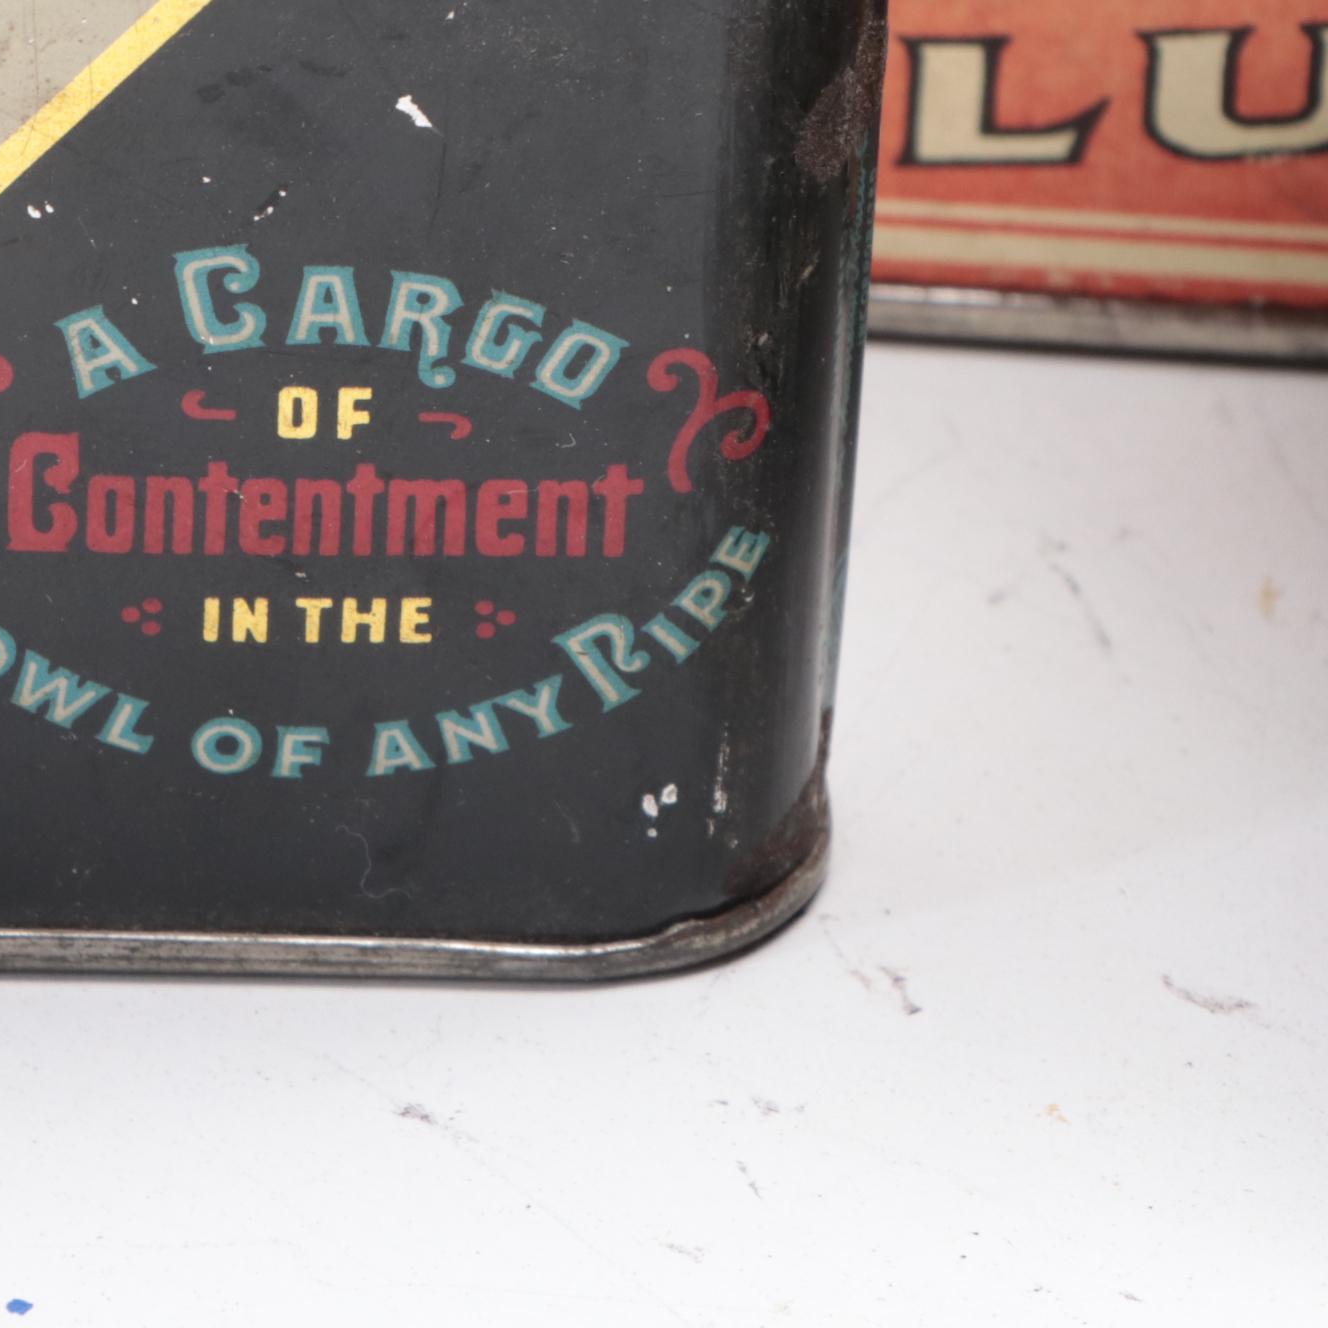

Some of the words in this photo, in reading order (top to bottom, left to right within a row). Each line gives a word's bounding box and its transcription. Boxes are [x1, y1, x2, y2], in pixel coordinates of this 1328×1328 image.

[56, 305, 158, 399] A
[172, 243, 631, 409] CARGO
[277, 386, 374, 440] OF
[6, 431, 644, 558] Contentment
[202, 597, 269, 643] IN
[295, 597, 432, 643] THE
[191, 717, 330, 778] OF
[366, 674, 574, 777] ANY
